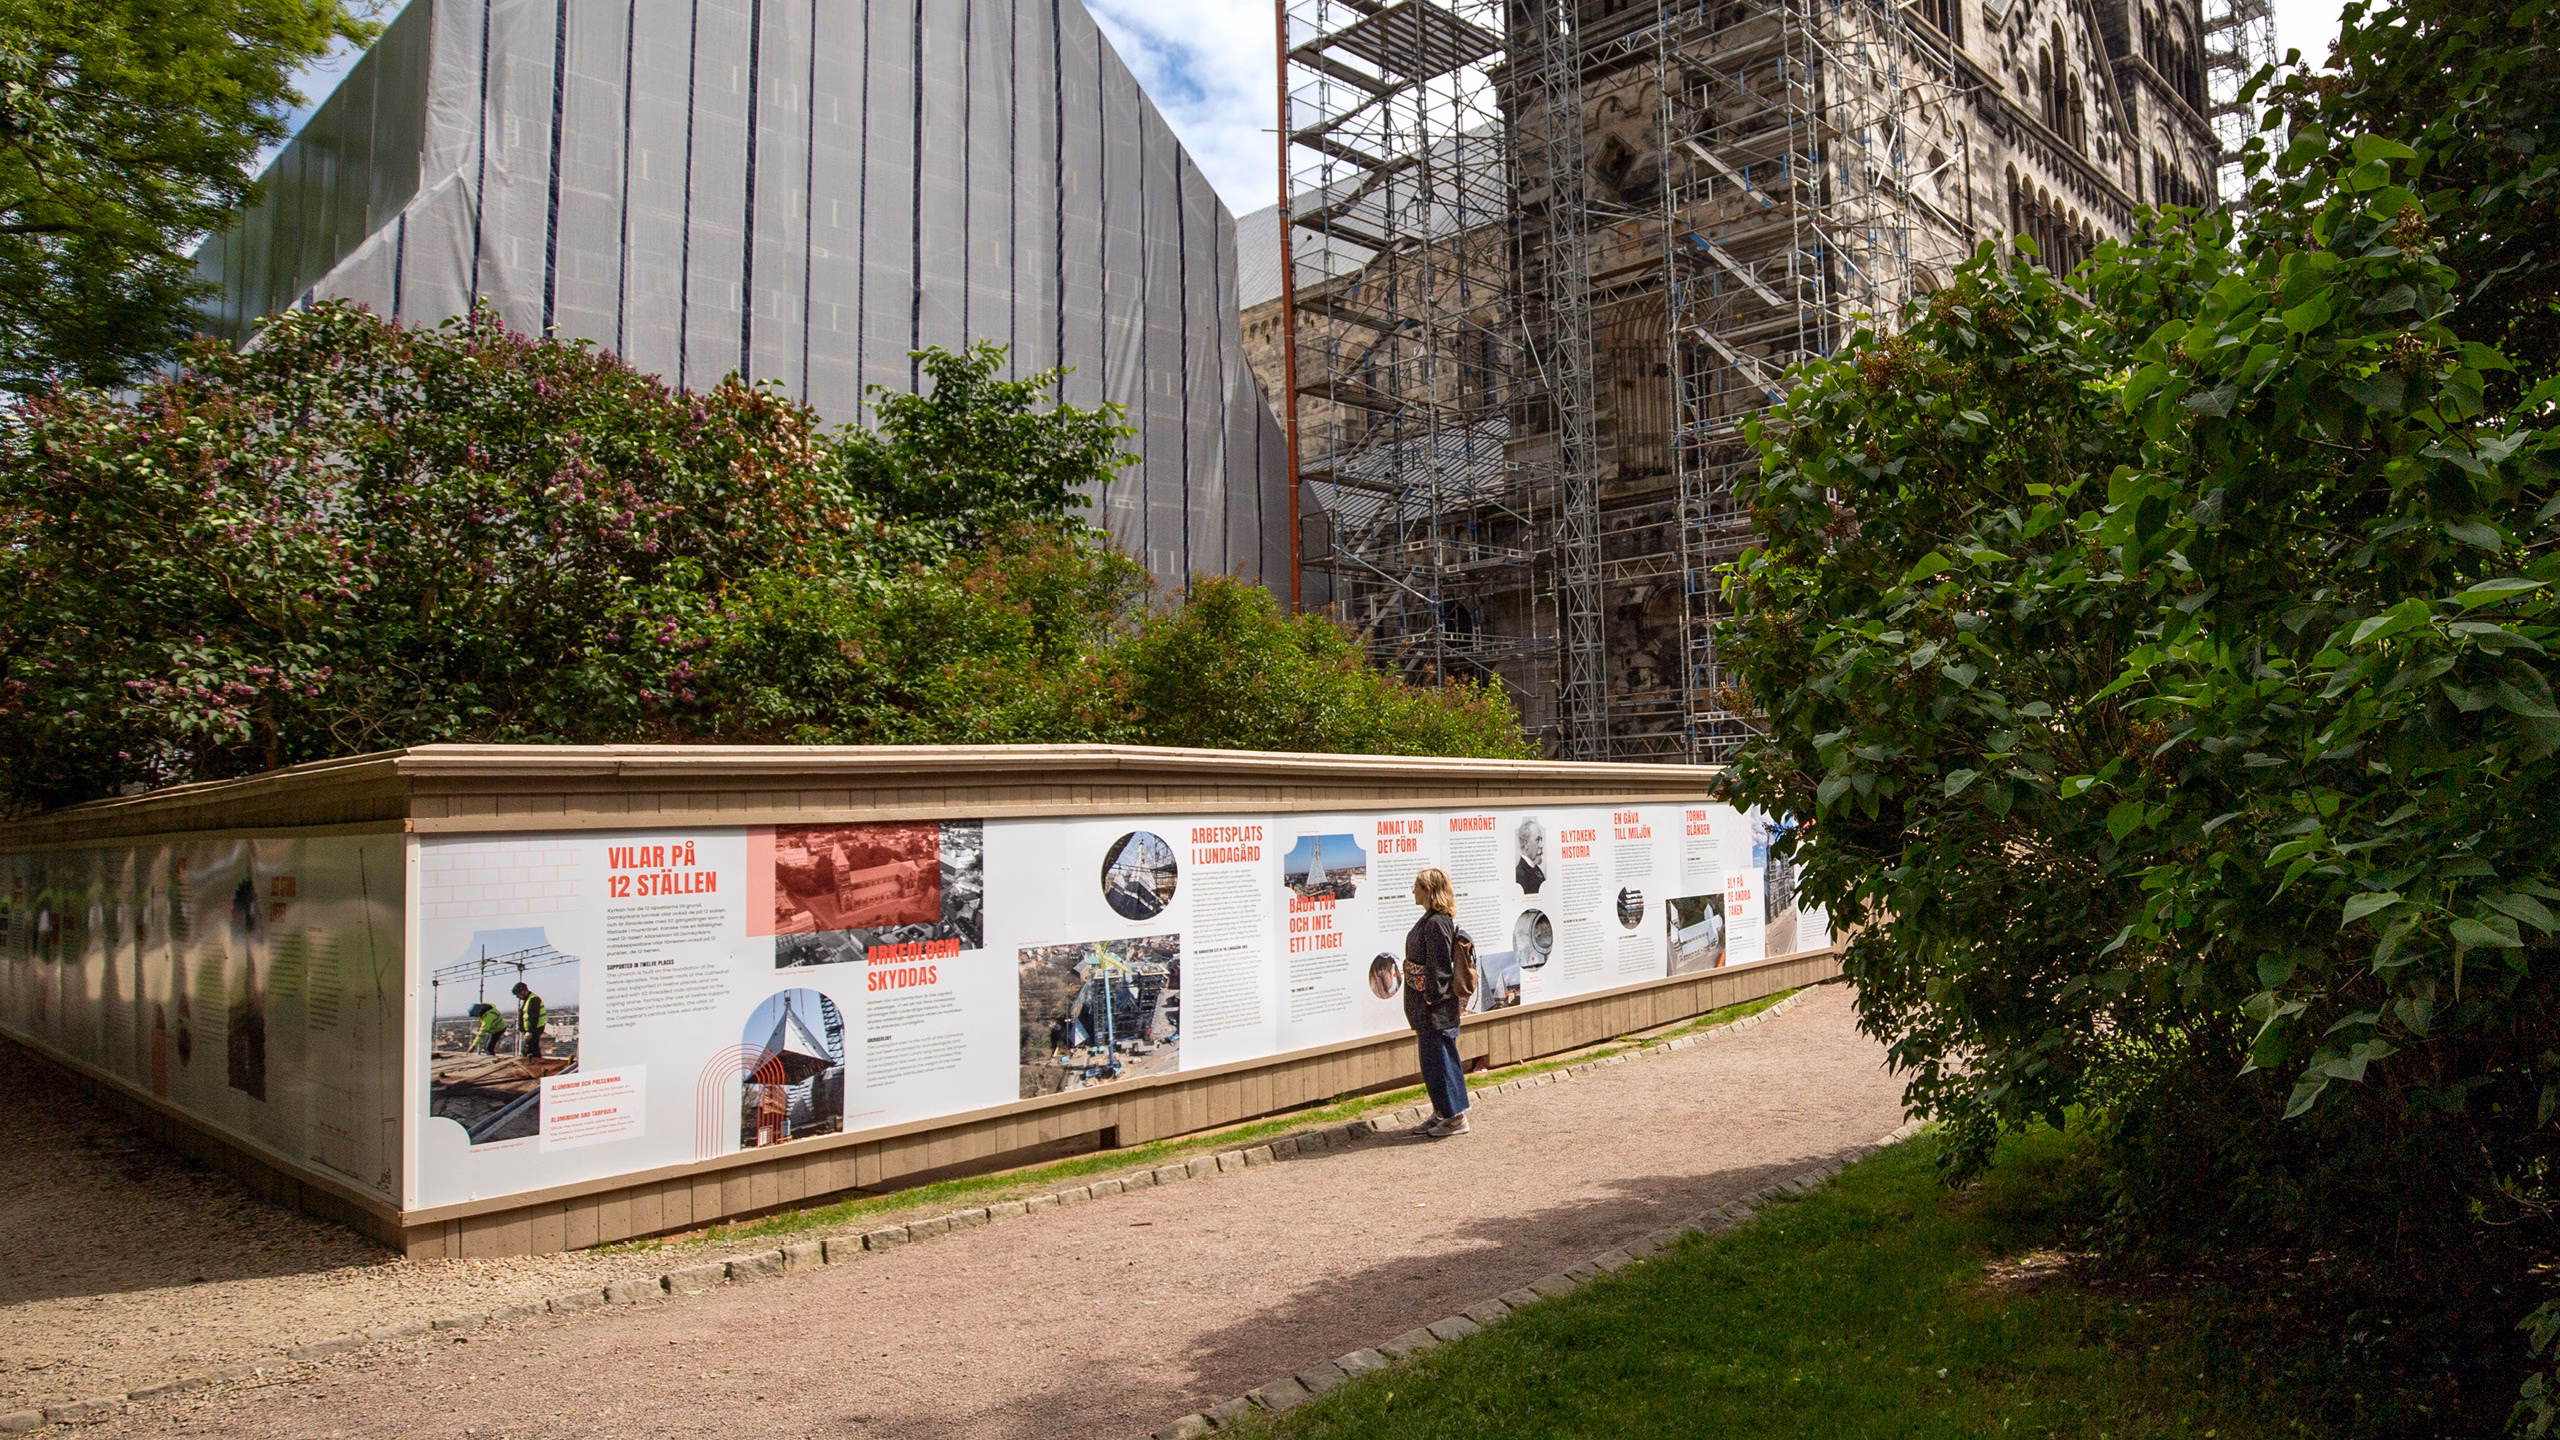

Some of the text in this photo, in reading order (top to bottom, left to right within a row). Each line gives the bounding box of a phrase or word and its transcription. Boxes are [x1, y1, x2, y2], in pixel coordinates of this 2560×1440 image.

[1450, 815, 1496, 832] MURKRÖNET
[1614, 810, 1639, 824] EN GÅVA
[1686, 810, 1706, 822] TORNEN
[1192, 826, 1262, 844] ARBETSPLATS
[1377, 820, 1423, 835] ANNAT VAR
[1561, 829, 1596, 843] BLYTAKENS
[1615, 825, 1651, 840] TILL MILJÖN
[1686, 822, 1710, 836] GLÄNSER
[1378, 836, 1417, 854] DET FÖRR
[1562, 846, 1590, 859] HISTORIA
[608, 840, 696, 869] VILAR PÅ
[1192, 844, 1260, 864] I LUNDAGÅRD
[608, 869, 716, 898] 12 STÄLLEN
[1737, 874, 1743, 887] PÅ
[1290, 892, 1335, 913] BÅDA TVÅ
[1728, 892, 1733, 902] DE
[1290, 914, 1332, 933] OCH INTE
[1290, 932, 1342, 953] ETT I TAGET
[868, 938, 960, 966] ARKEOLOGIN
[868, 966, 936, 991] SKYDDAS
